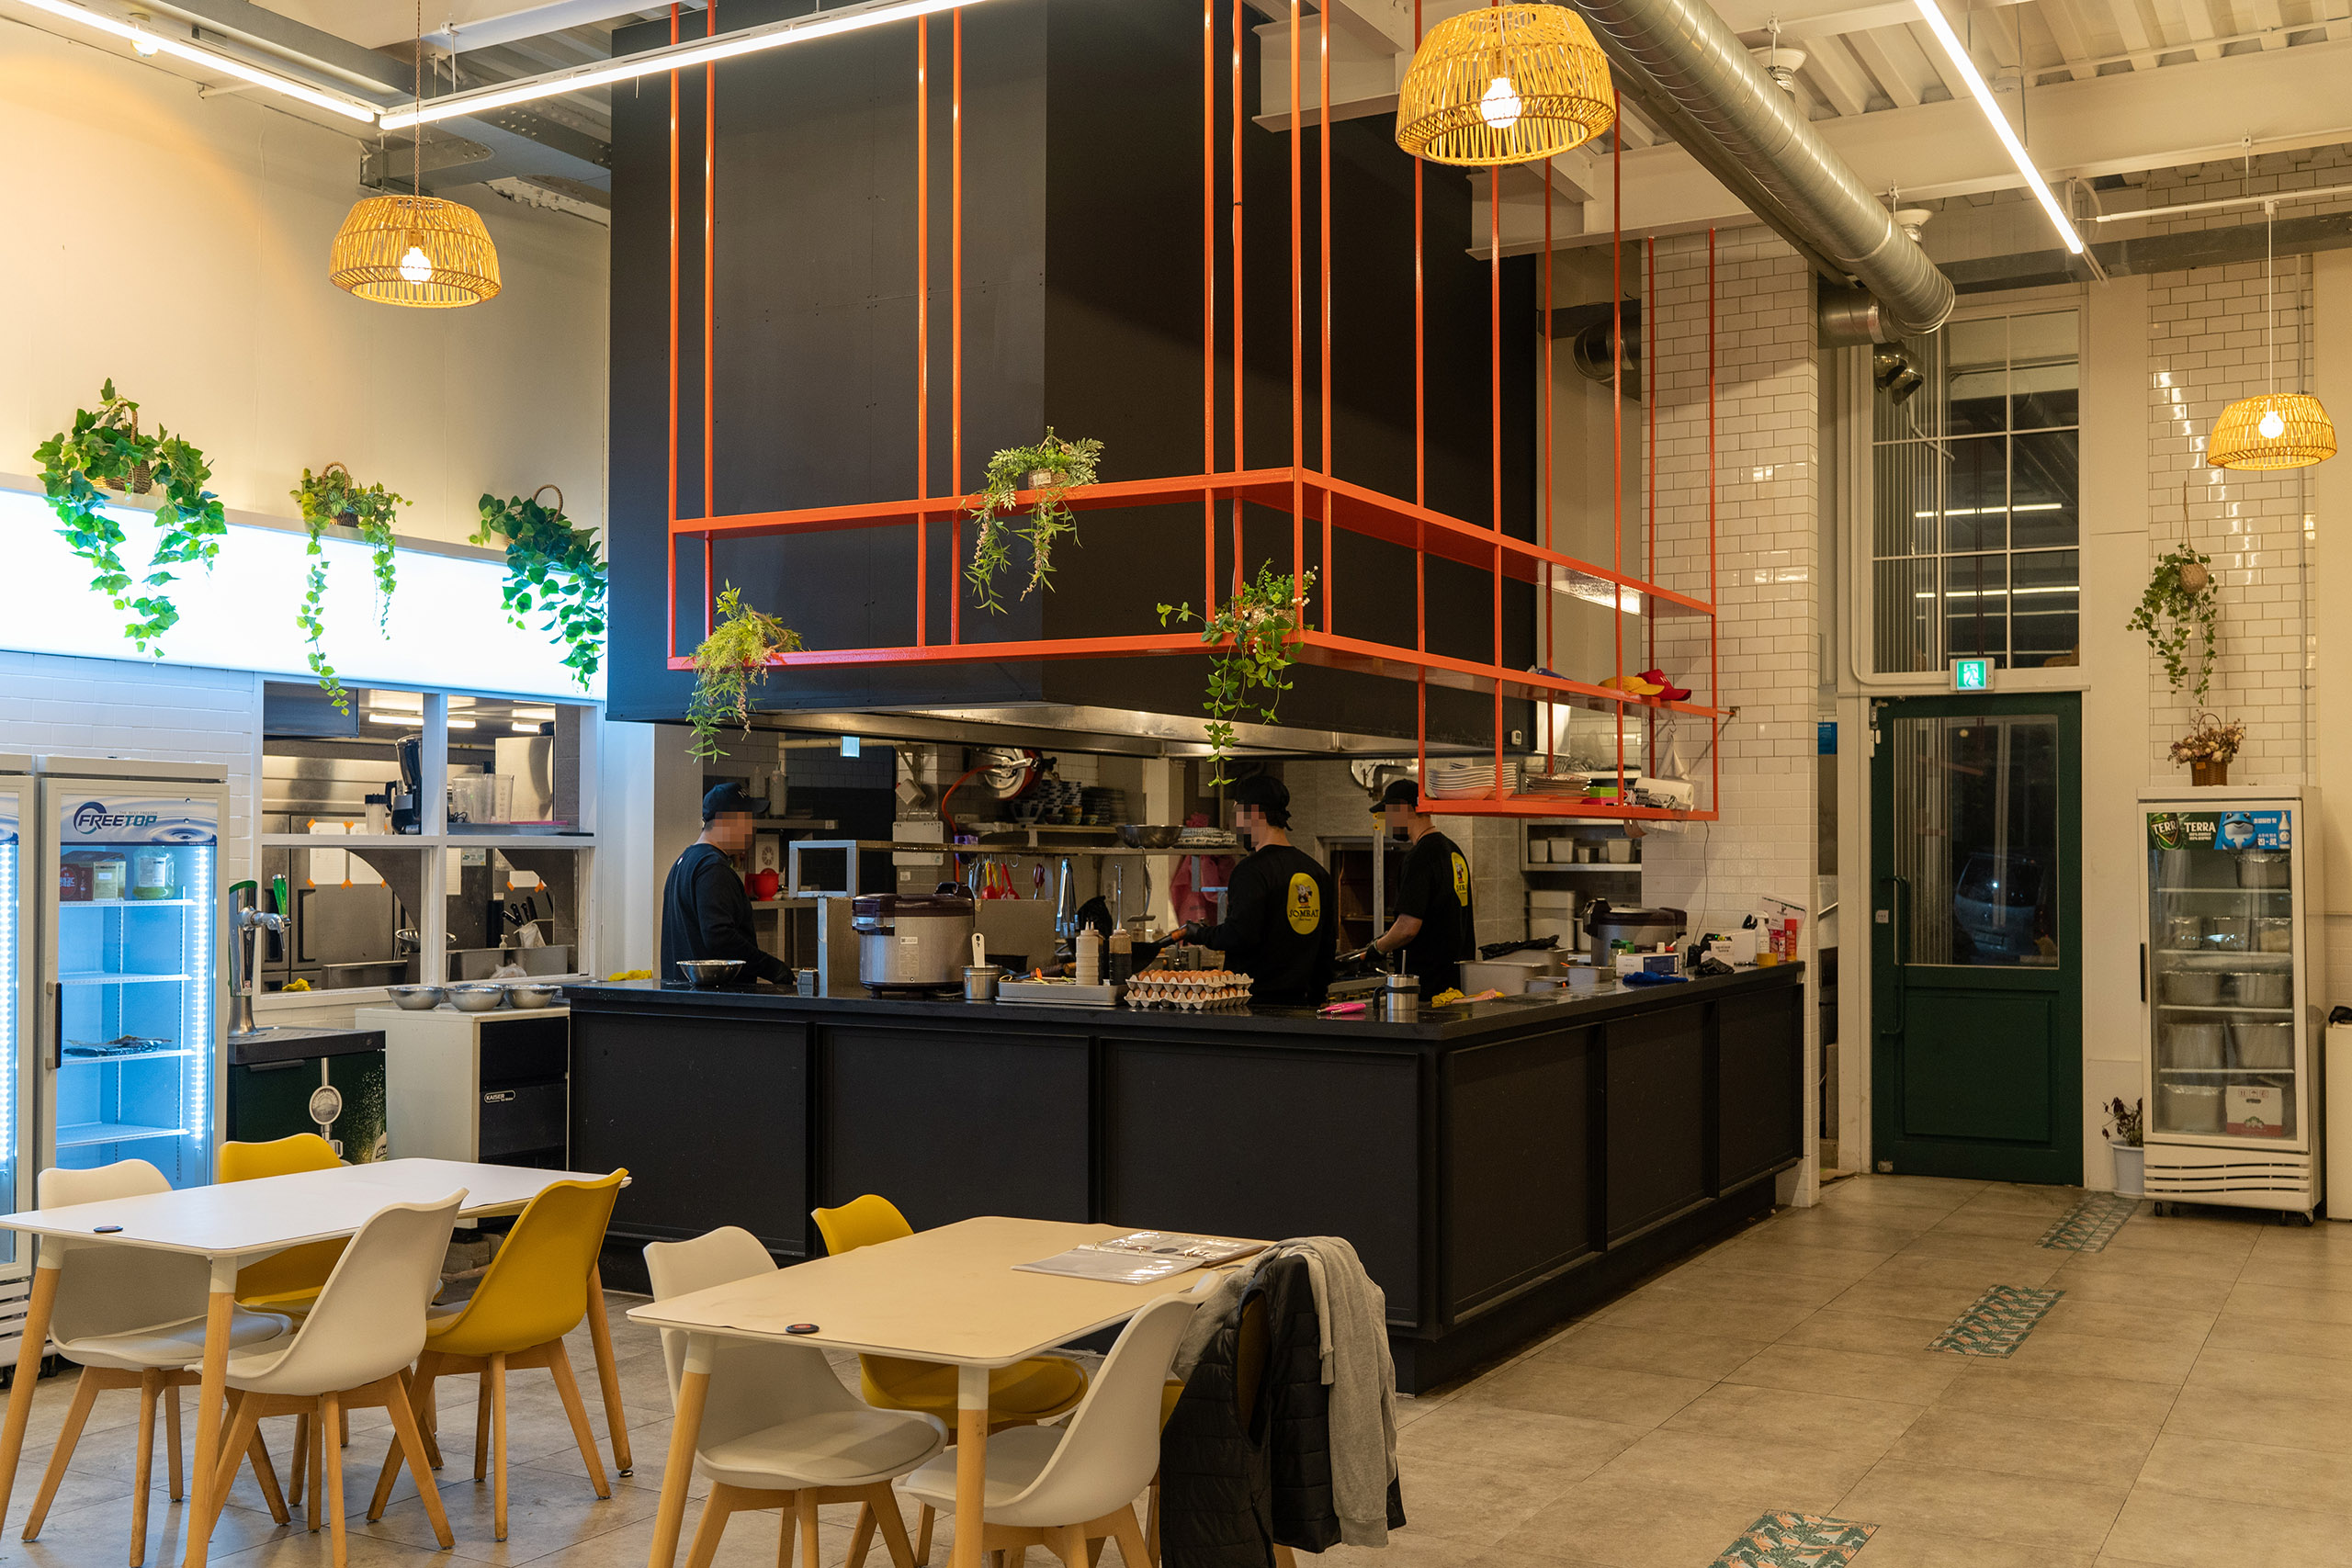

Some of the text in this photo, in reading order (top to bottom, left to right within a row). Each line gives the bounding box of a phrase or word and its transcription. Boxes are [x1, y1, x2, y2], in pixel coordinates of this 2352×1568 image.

[77, 815, 157, 829] FREETOP
[2184, 822, 2216, 832] TERRA
[1289, 909, 1318, 918] SOMBAT
